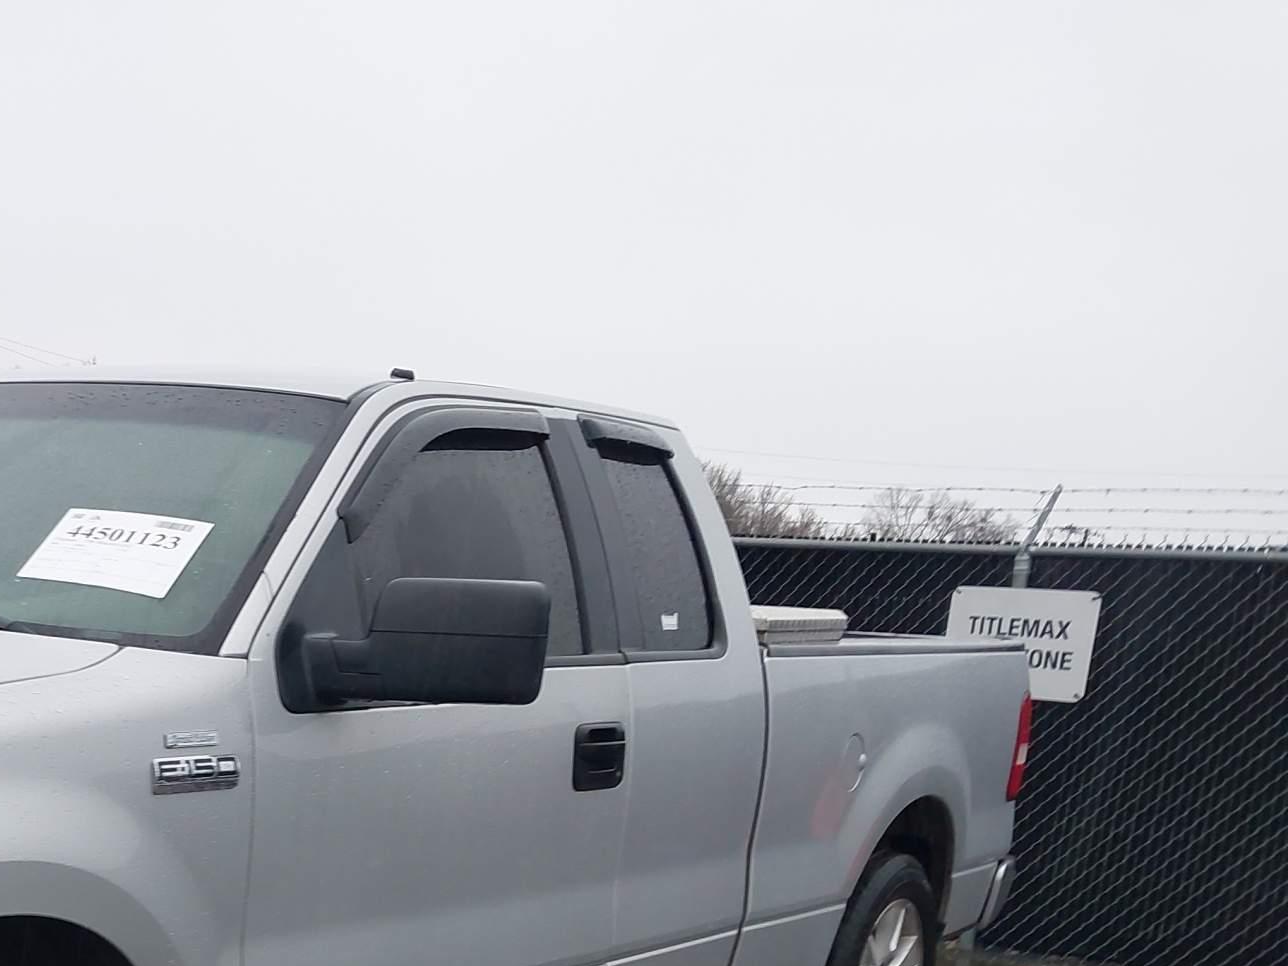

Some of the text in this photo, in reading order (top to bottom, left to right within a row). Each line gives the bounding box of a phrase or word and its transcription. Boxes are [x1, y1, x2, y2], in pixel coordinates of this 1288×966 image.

[66, 525, 181, 550] 44501123
[968, 615, 1073, 640] TITLEMAX
[1025, 649, 1074, 671] ONE
